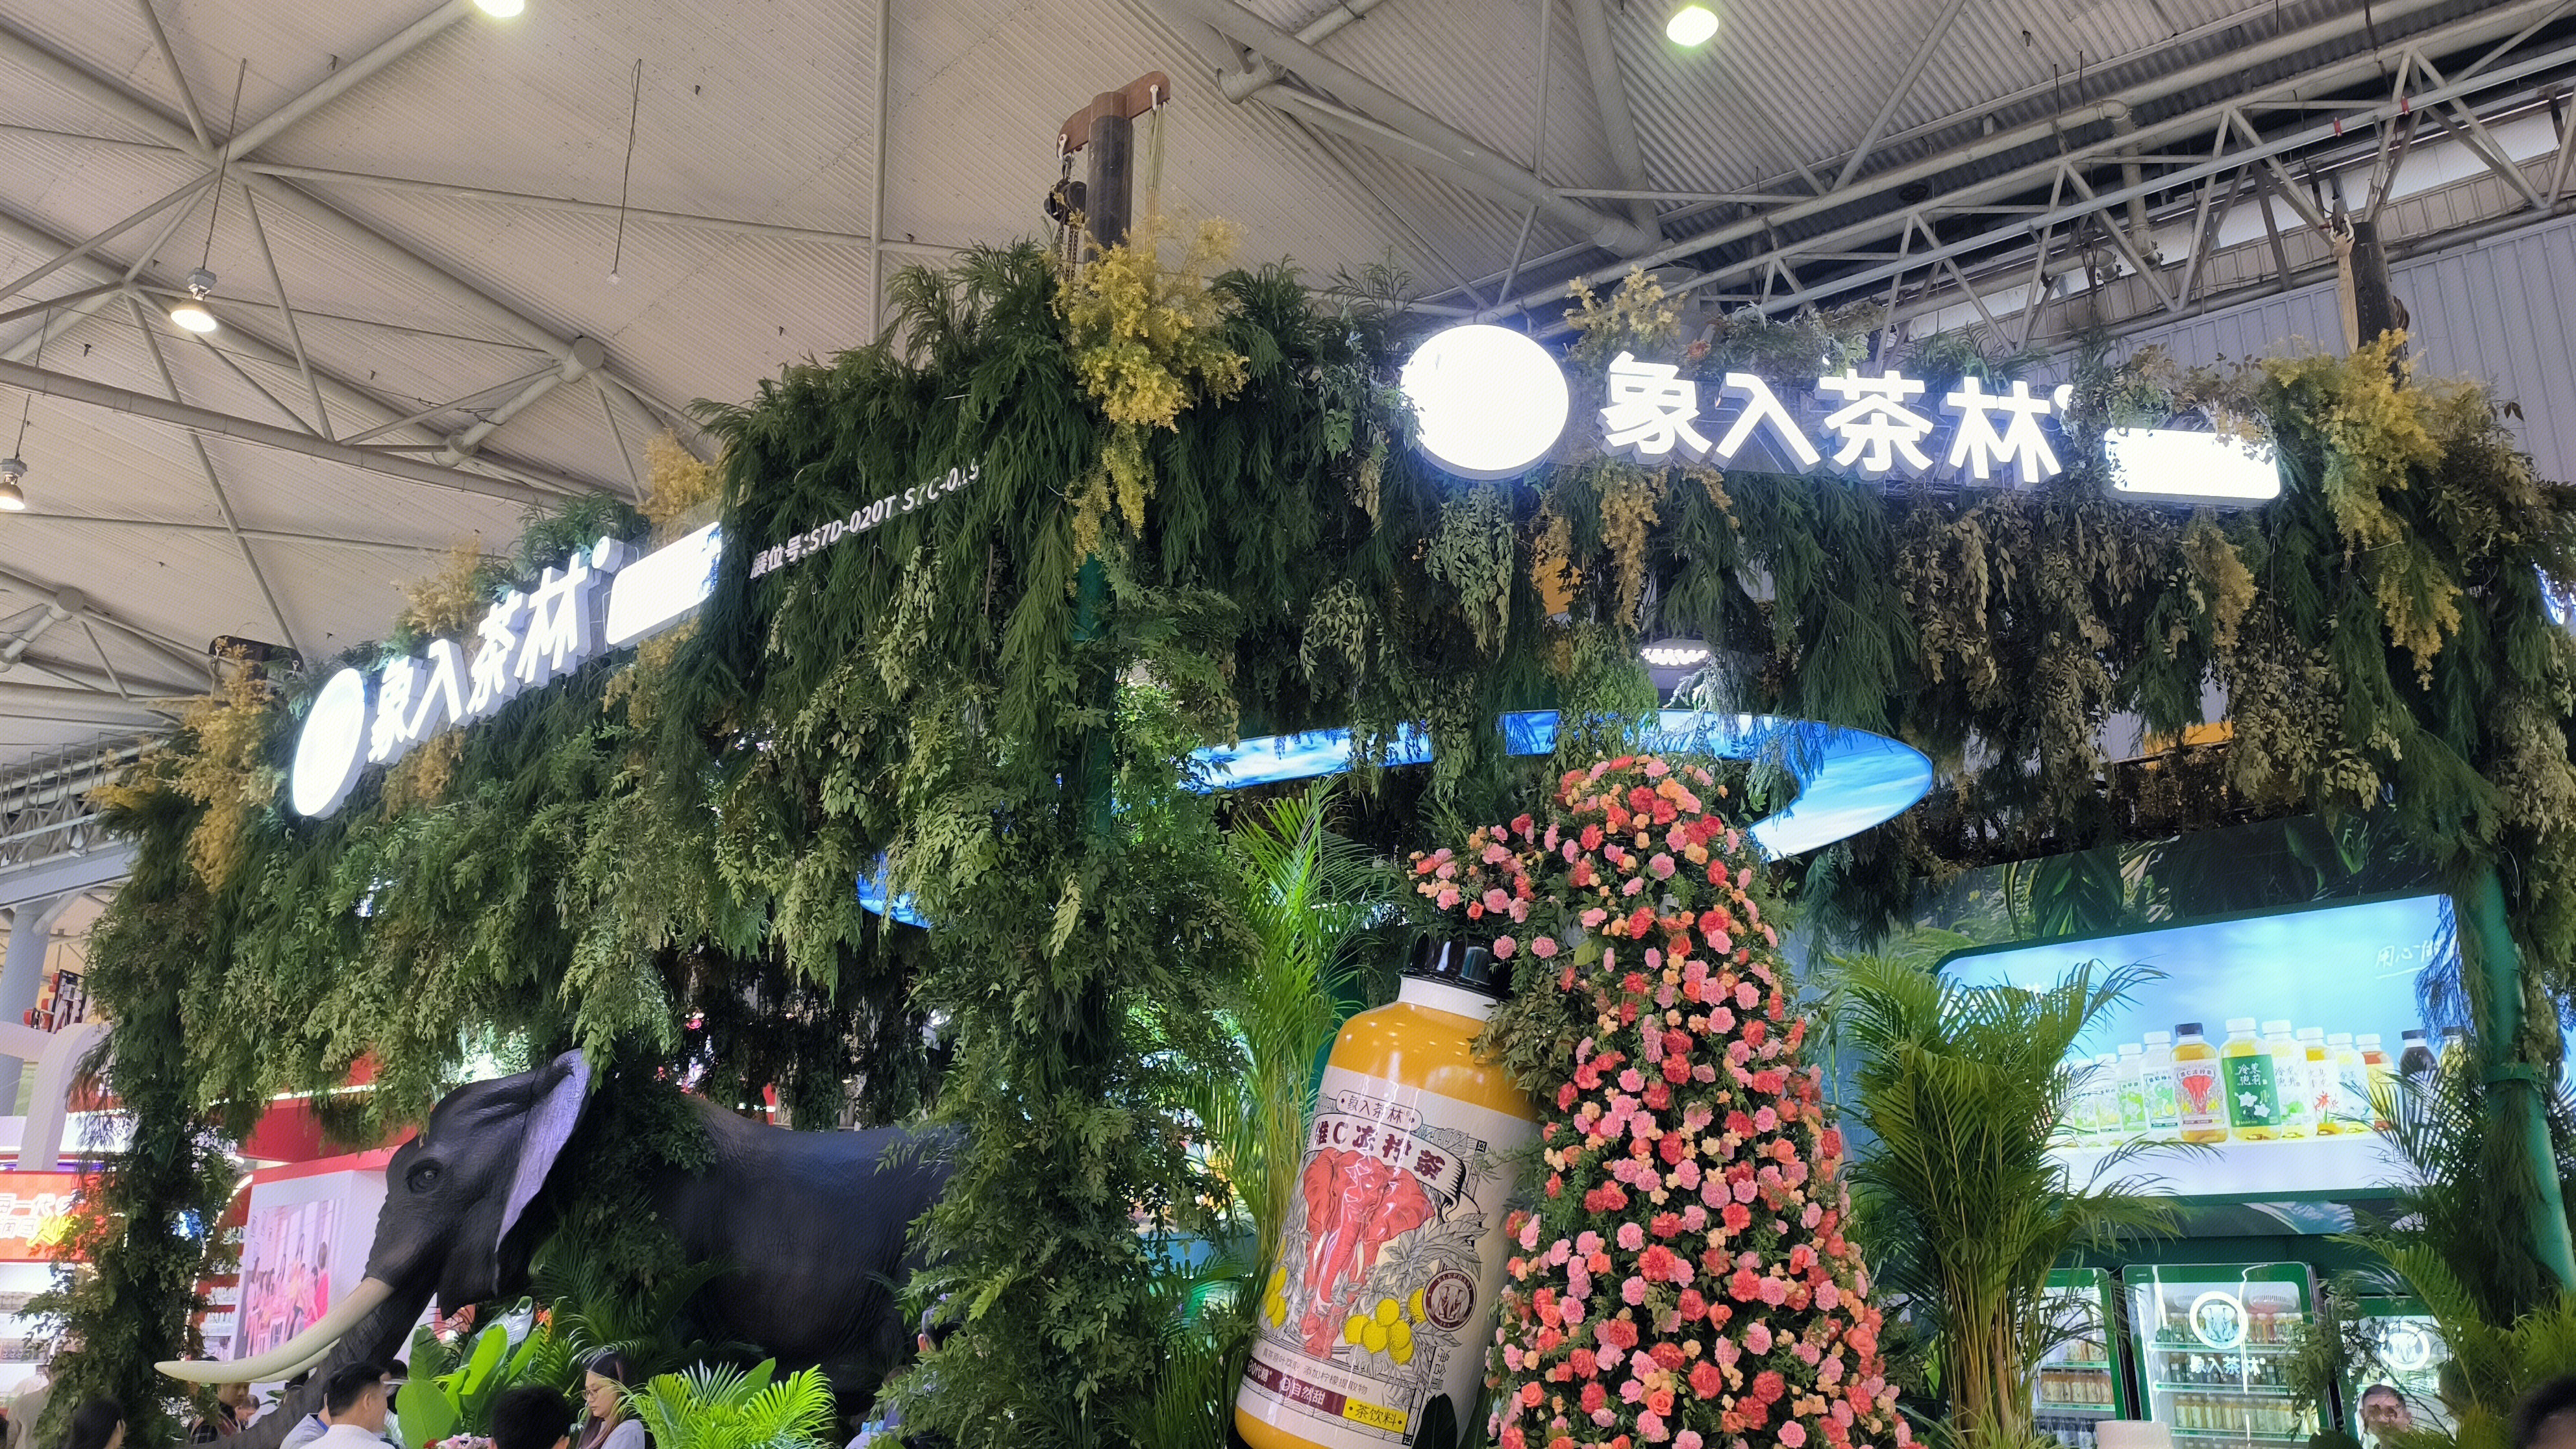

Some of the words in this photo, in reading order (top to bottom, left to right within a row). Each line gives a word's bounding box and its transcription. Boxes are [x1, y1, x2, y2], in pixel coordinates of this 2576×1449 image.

[1600, 351, 2062, 483] 象入茶林
[367, 552, 588, 763] 象入茶林
[1347, 1095, 1404, 1124] 象入茶林
[1355, 1403, 1397, 1428] 茶饮料
